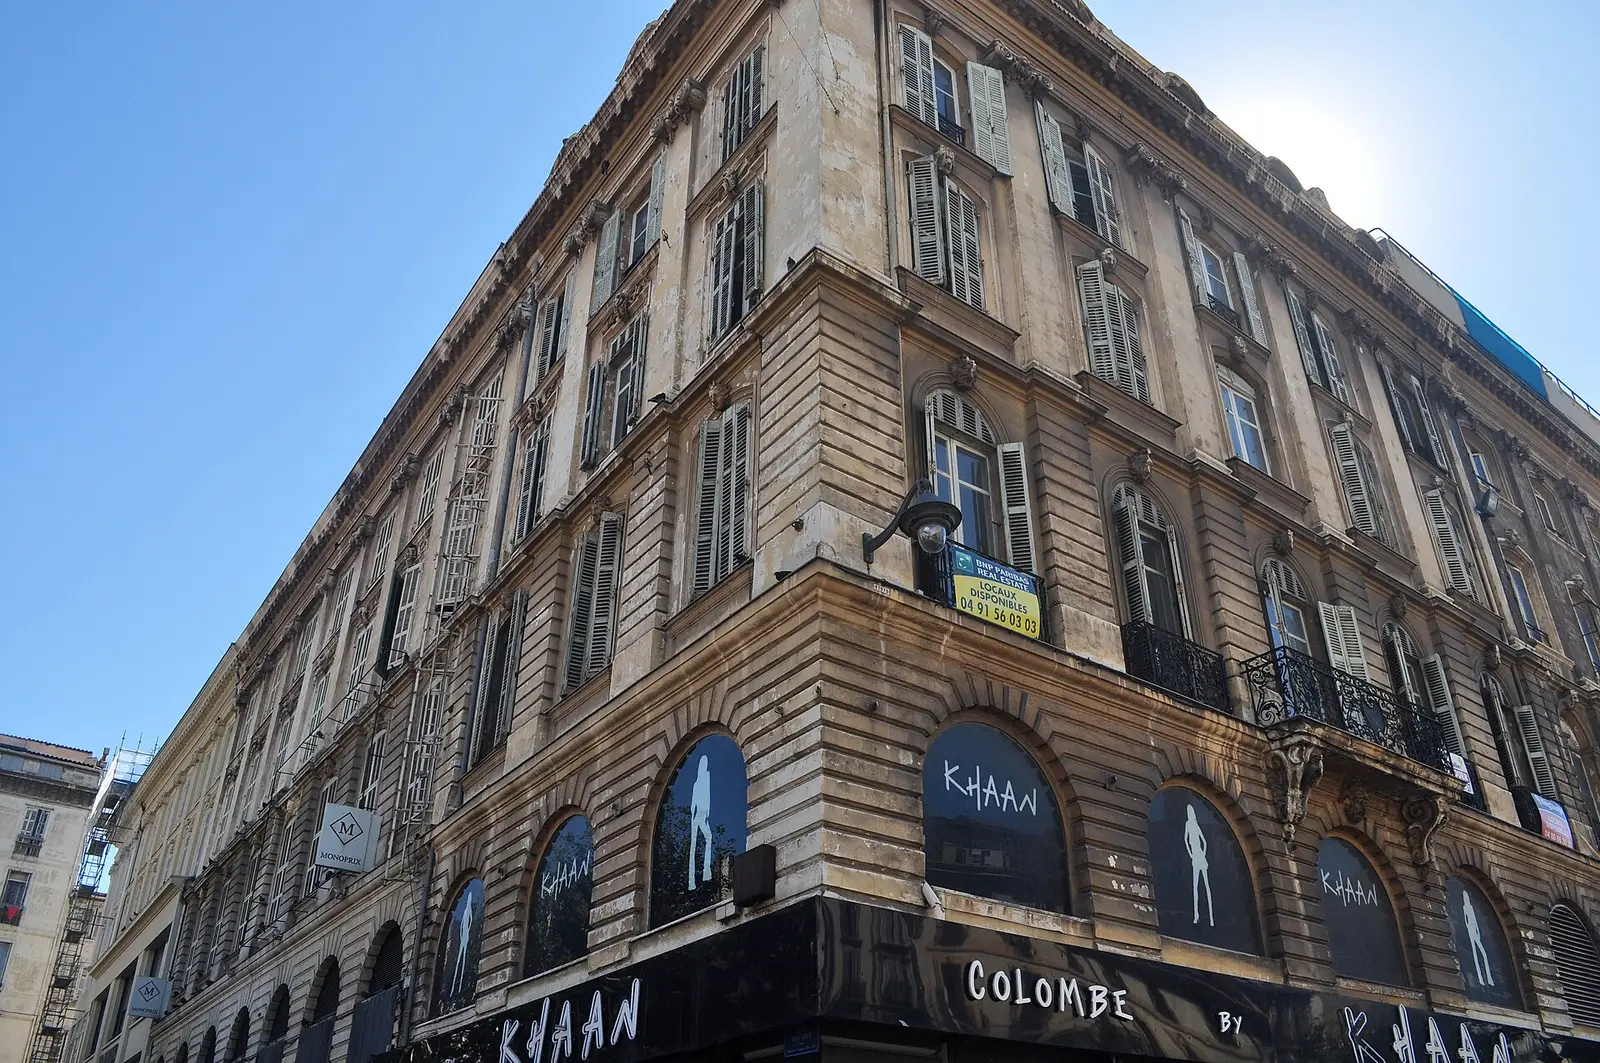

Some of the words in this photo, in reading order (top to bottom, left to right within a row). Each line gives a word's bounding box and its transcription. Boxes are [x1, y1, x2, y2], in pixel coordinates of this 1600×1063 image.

[975, 559, 994, 571] BNP
[994, 566, 1030, 585] PARIBAS
[977, 568, 1000, 582] REAL
[1000, 576, 1030, 592] ESTATE
[970, 588, 1028, 614] DISPONIBLES
[980, 581, 1017, 600] LOCAUX
[960, 596, 974, 612] 04
[977, 602, 989, 617] 91
[994, 608, 1006, 623] 56
[1009, 613, 1022, 629] 03
[1025, 618, 1037, 634] 03
[944, 759, 1037, 816] KHAAN
[338, 821, 356, 836] M
[320, 852, 362, 865] MONOPRIX
[540, 849, 591, 901] KHAAN
[1320, 868, 1378, 907] KHAAN
[143, 986, 155, 996] M
[968, 959, 1134, 1021] COLOMBE
[499, 977, 641, 1063] KHAAN
